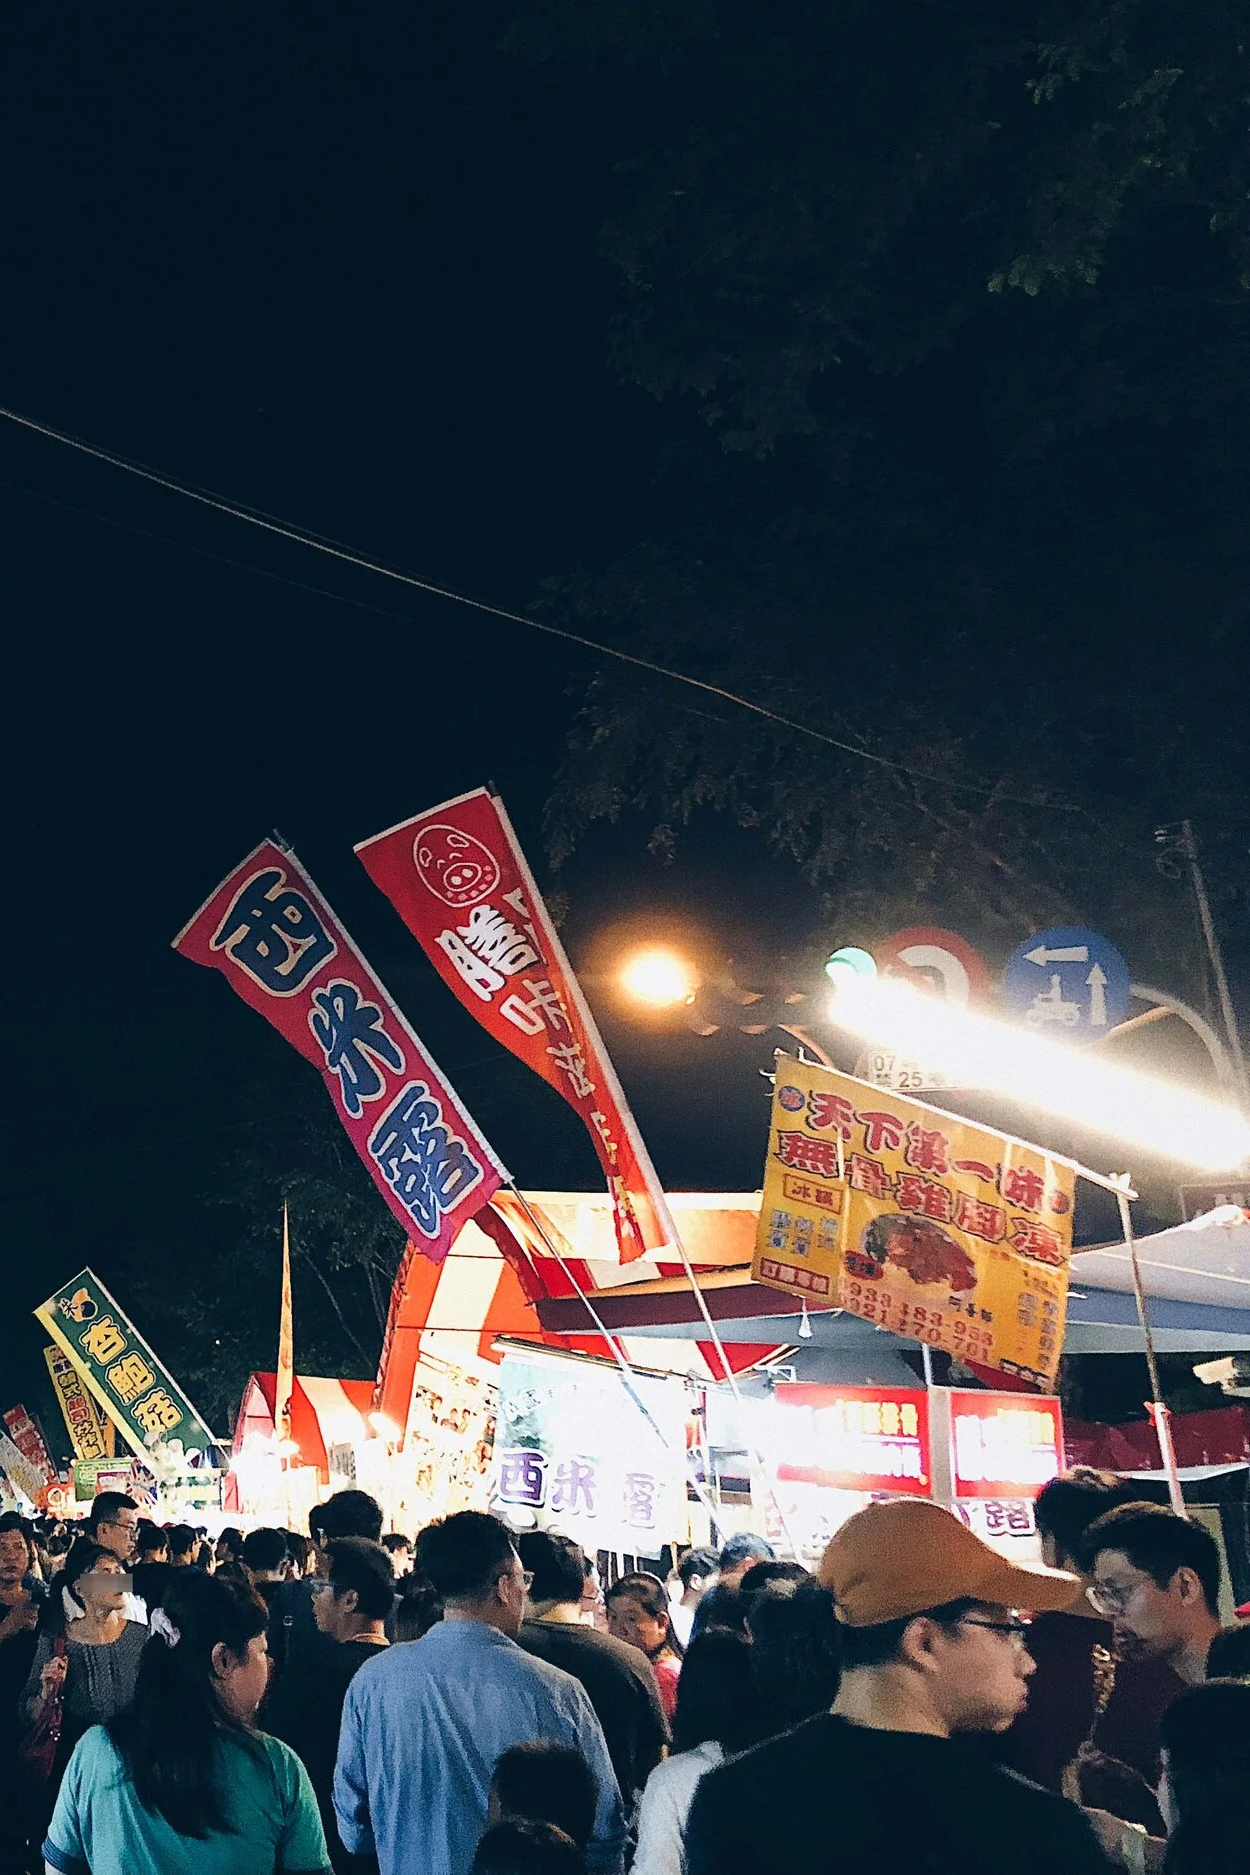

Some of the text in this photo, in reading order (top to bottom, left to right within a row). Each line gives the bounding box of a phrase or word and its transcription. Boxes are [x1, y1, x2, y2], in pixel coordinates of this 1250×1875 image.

[210, 867, 484, 1240] 西米露
[874, 1055, 896, 1071] 07
[899, 1072, 923, 1087] 25
[807, 1090, 1048, 1214] 天下第一味
[80, 1315, 184, 1434] 杏鮑菇
